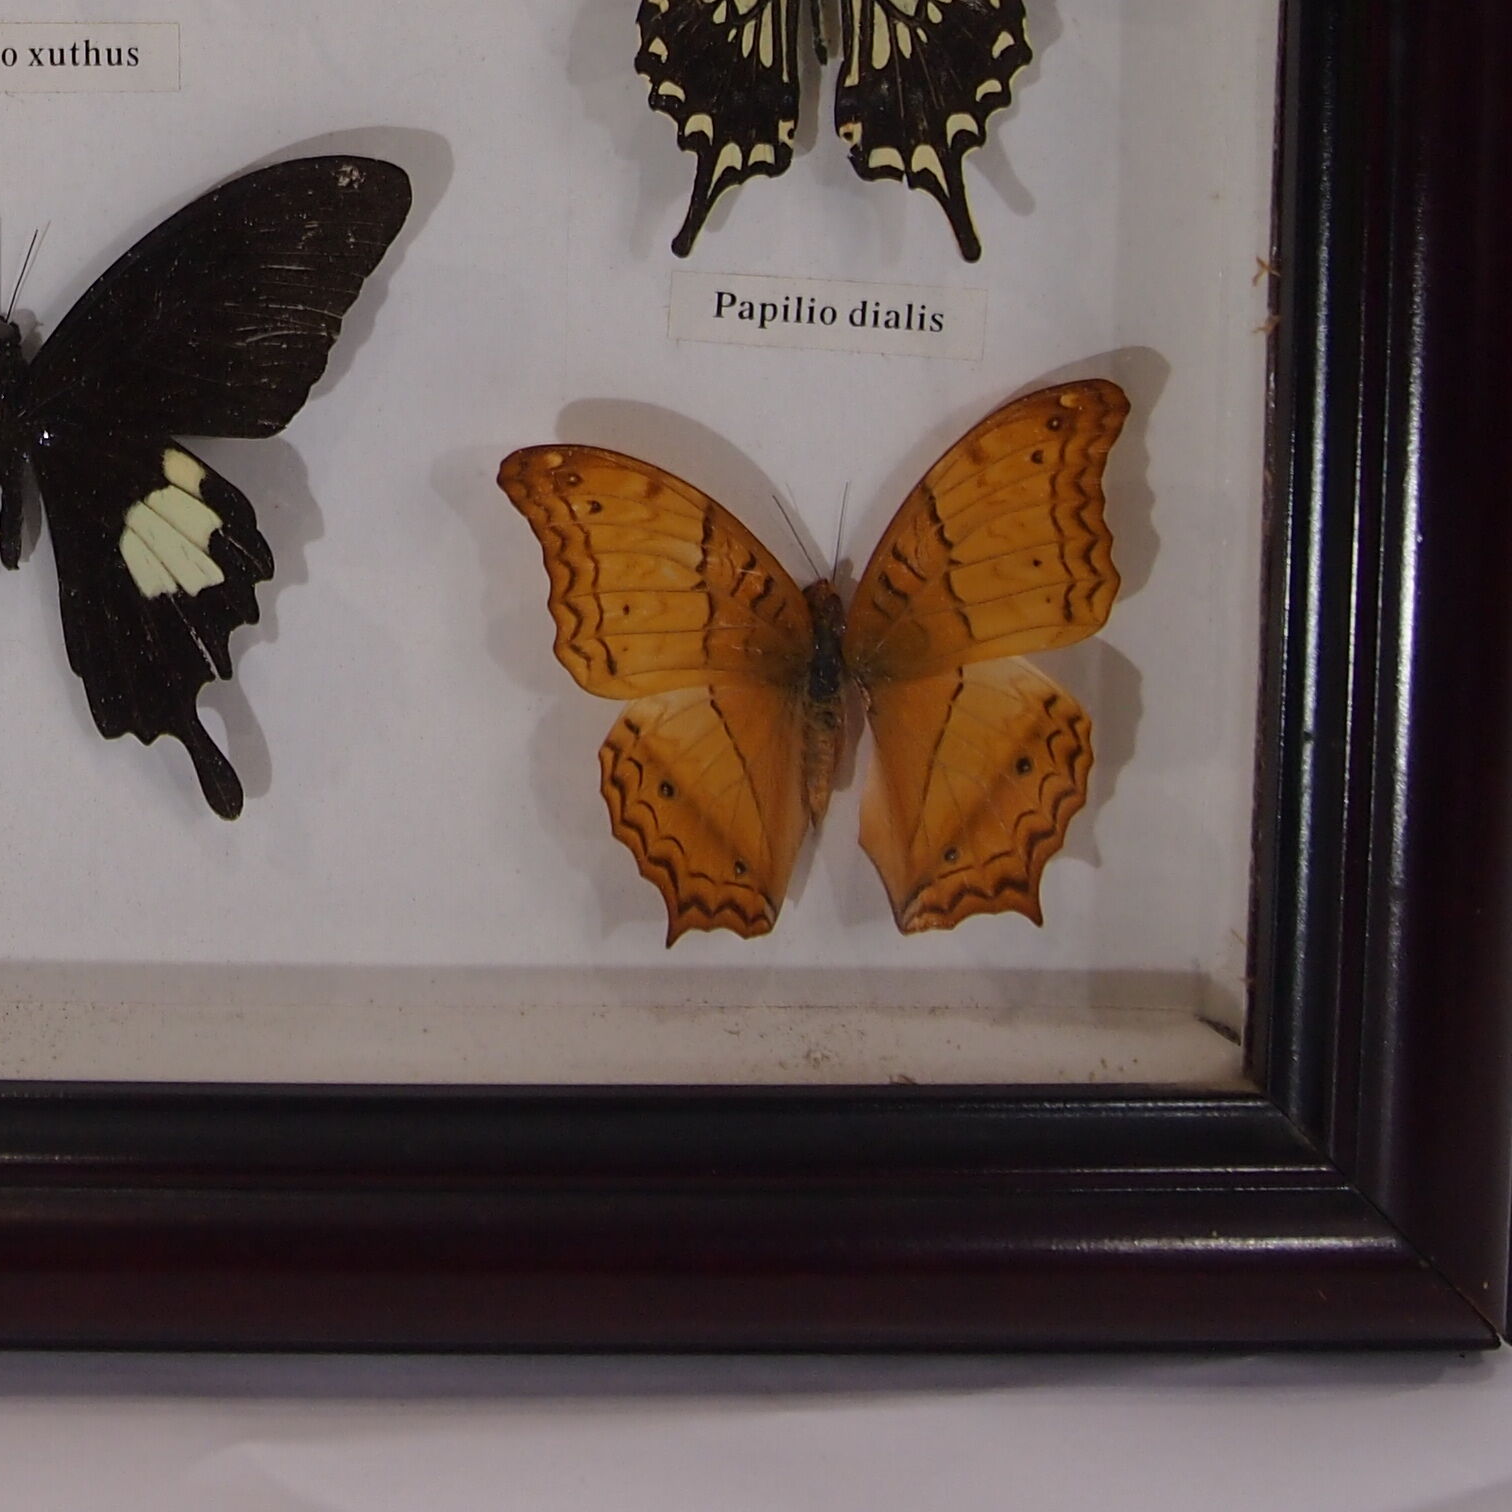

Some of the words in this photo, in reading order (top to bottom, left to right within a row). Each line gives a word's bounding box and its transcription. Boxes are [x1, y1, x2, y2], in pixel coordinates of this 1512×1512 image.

[27, 38, 140, 67] xuthus
[713, 290, 838, 330] Papilio
[848, 300, 944, 333] dialis
